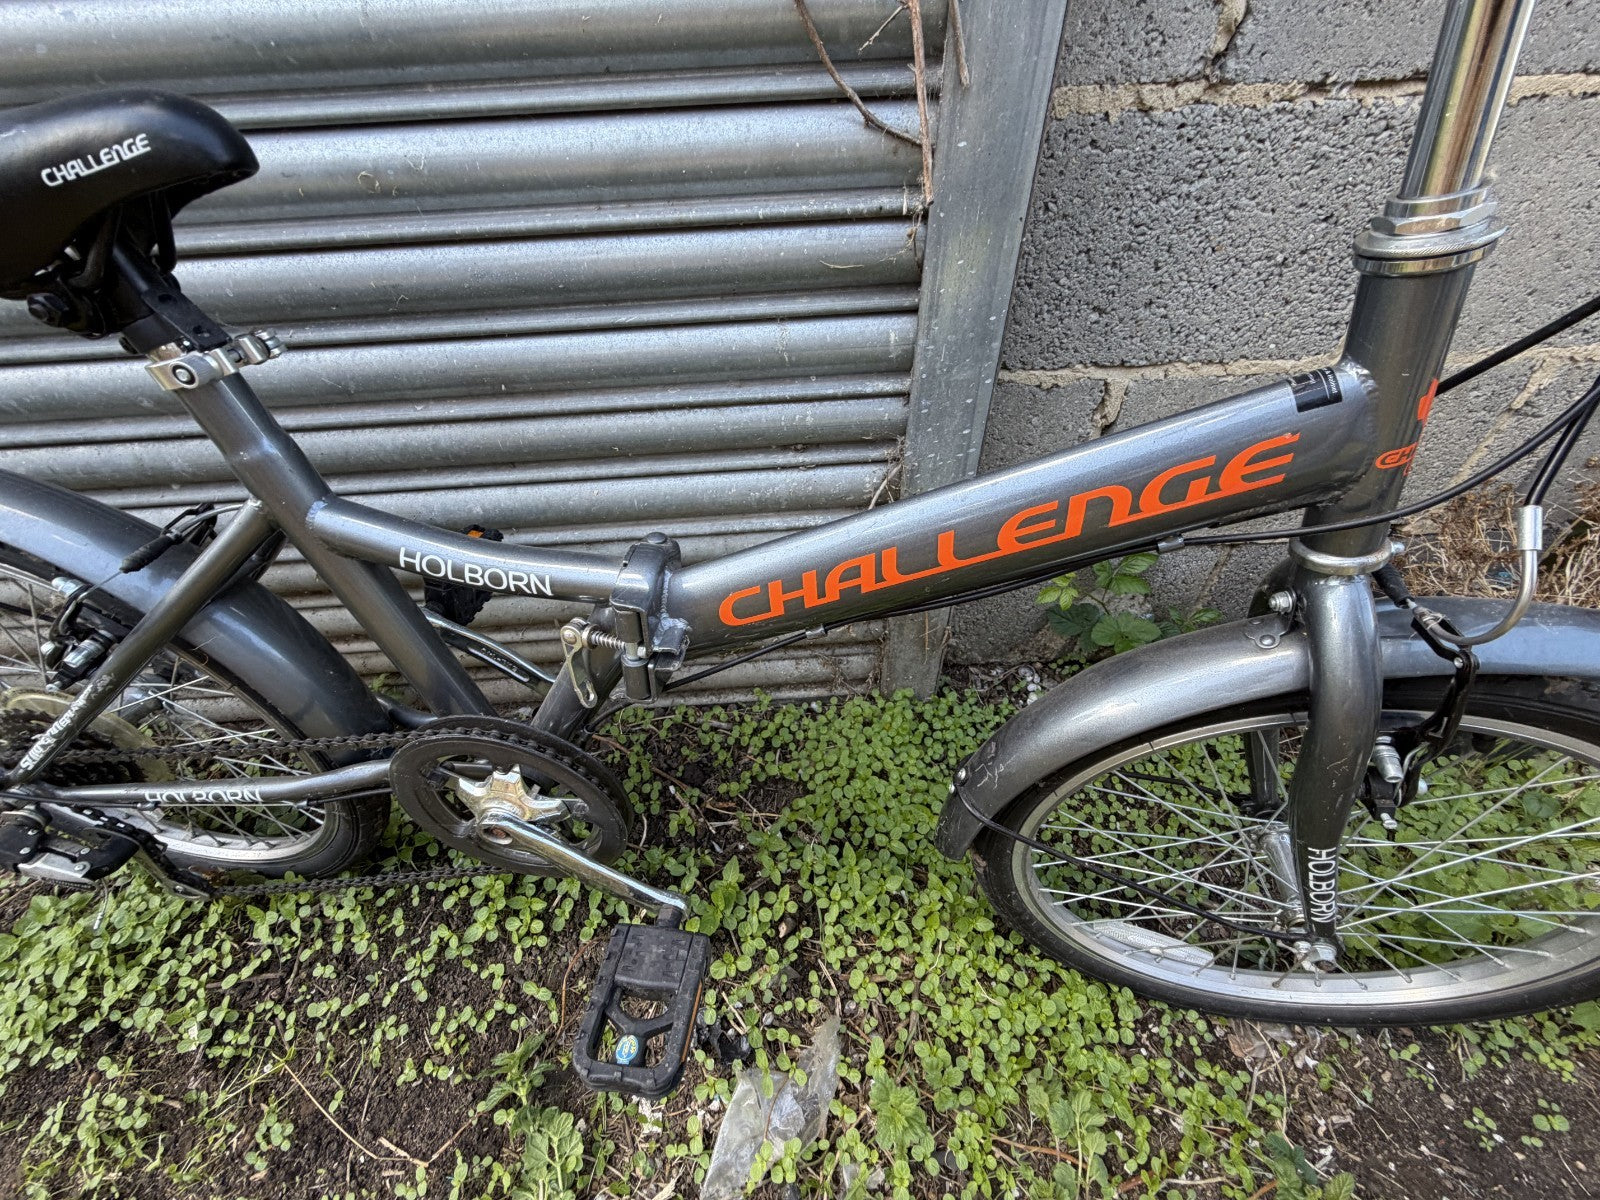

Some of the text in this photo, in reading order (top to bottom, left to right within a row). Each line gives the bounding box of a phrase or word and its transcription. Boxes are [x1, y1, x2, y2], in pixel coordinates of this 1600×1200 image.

[41, 133, 151, 187] CHALLENGE
[719, 432, 1300, 627] CHALLENGE
[399, 546, 554, 597] HOLBORN
[1308, 846, 1337, 923] HOLBORN
